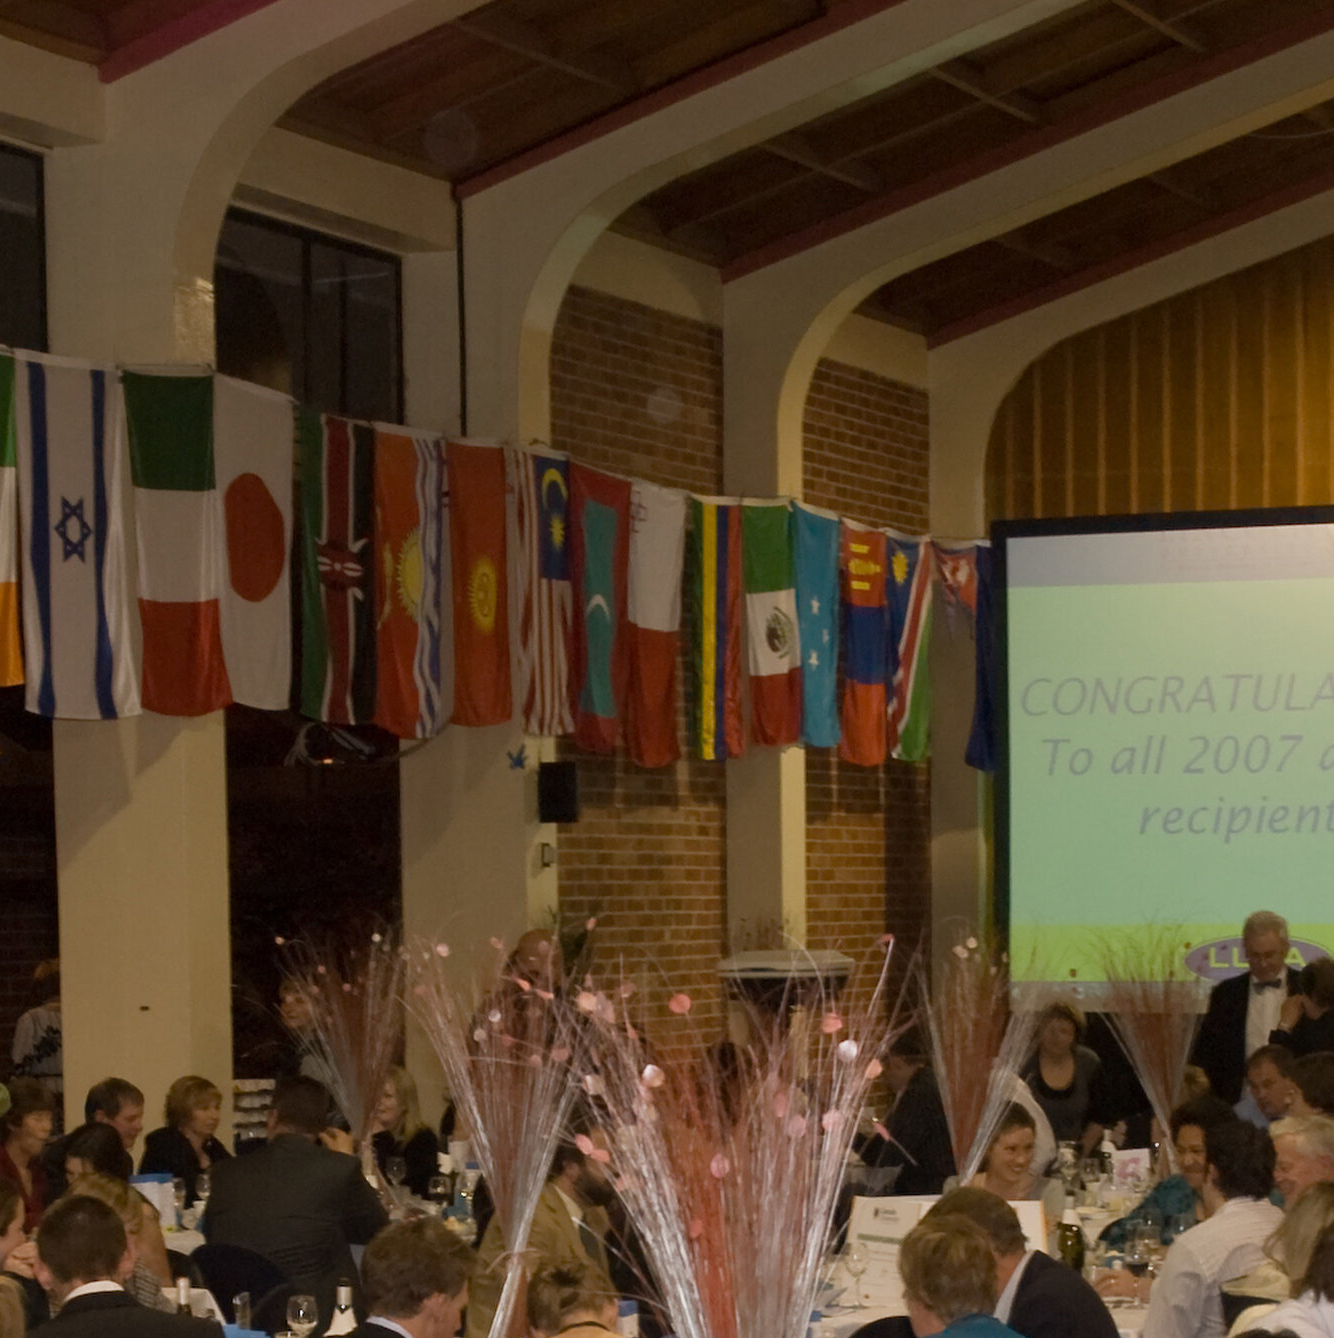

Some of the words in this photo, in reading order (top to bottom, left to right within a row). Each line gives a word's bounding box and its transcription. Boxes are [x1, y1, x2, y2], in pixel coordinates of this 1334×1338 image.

[1042, 737, 1094, 777] To
[1110, 734, 1168, 776] all
[1182, 733, 1304, 775] 2007
[1207, 945, 1308, 969] LUA
